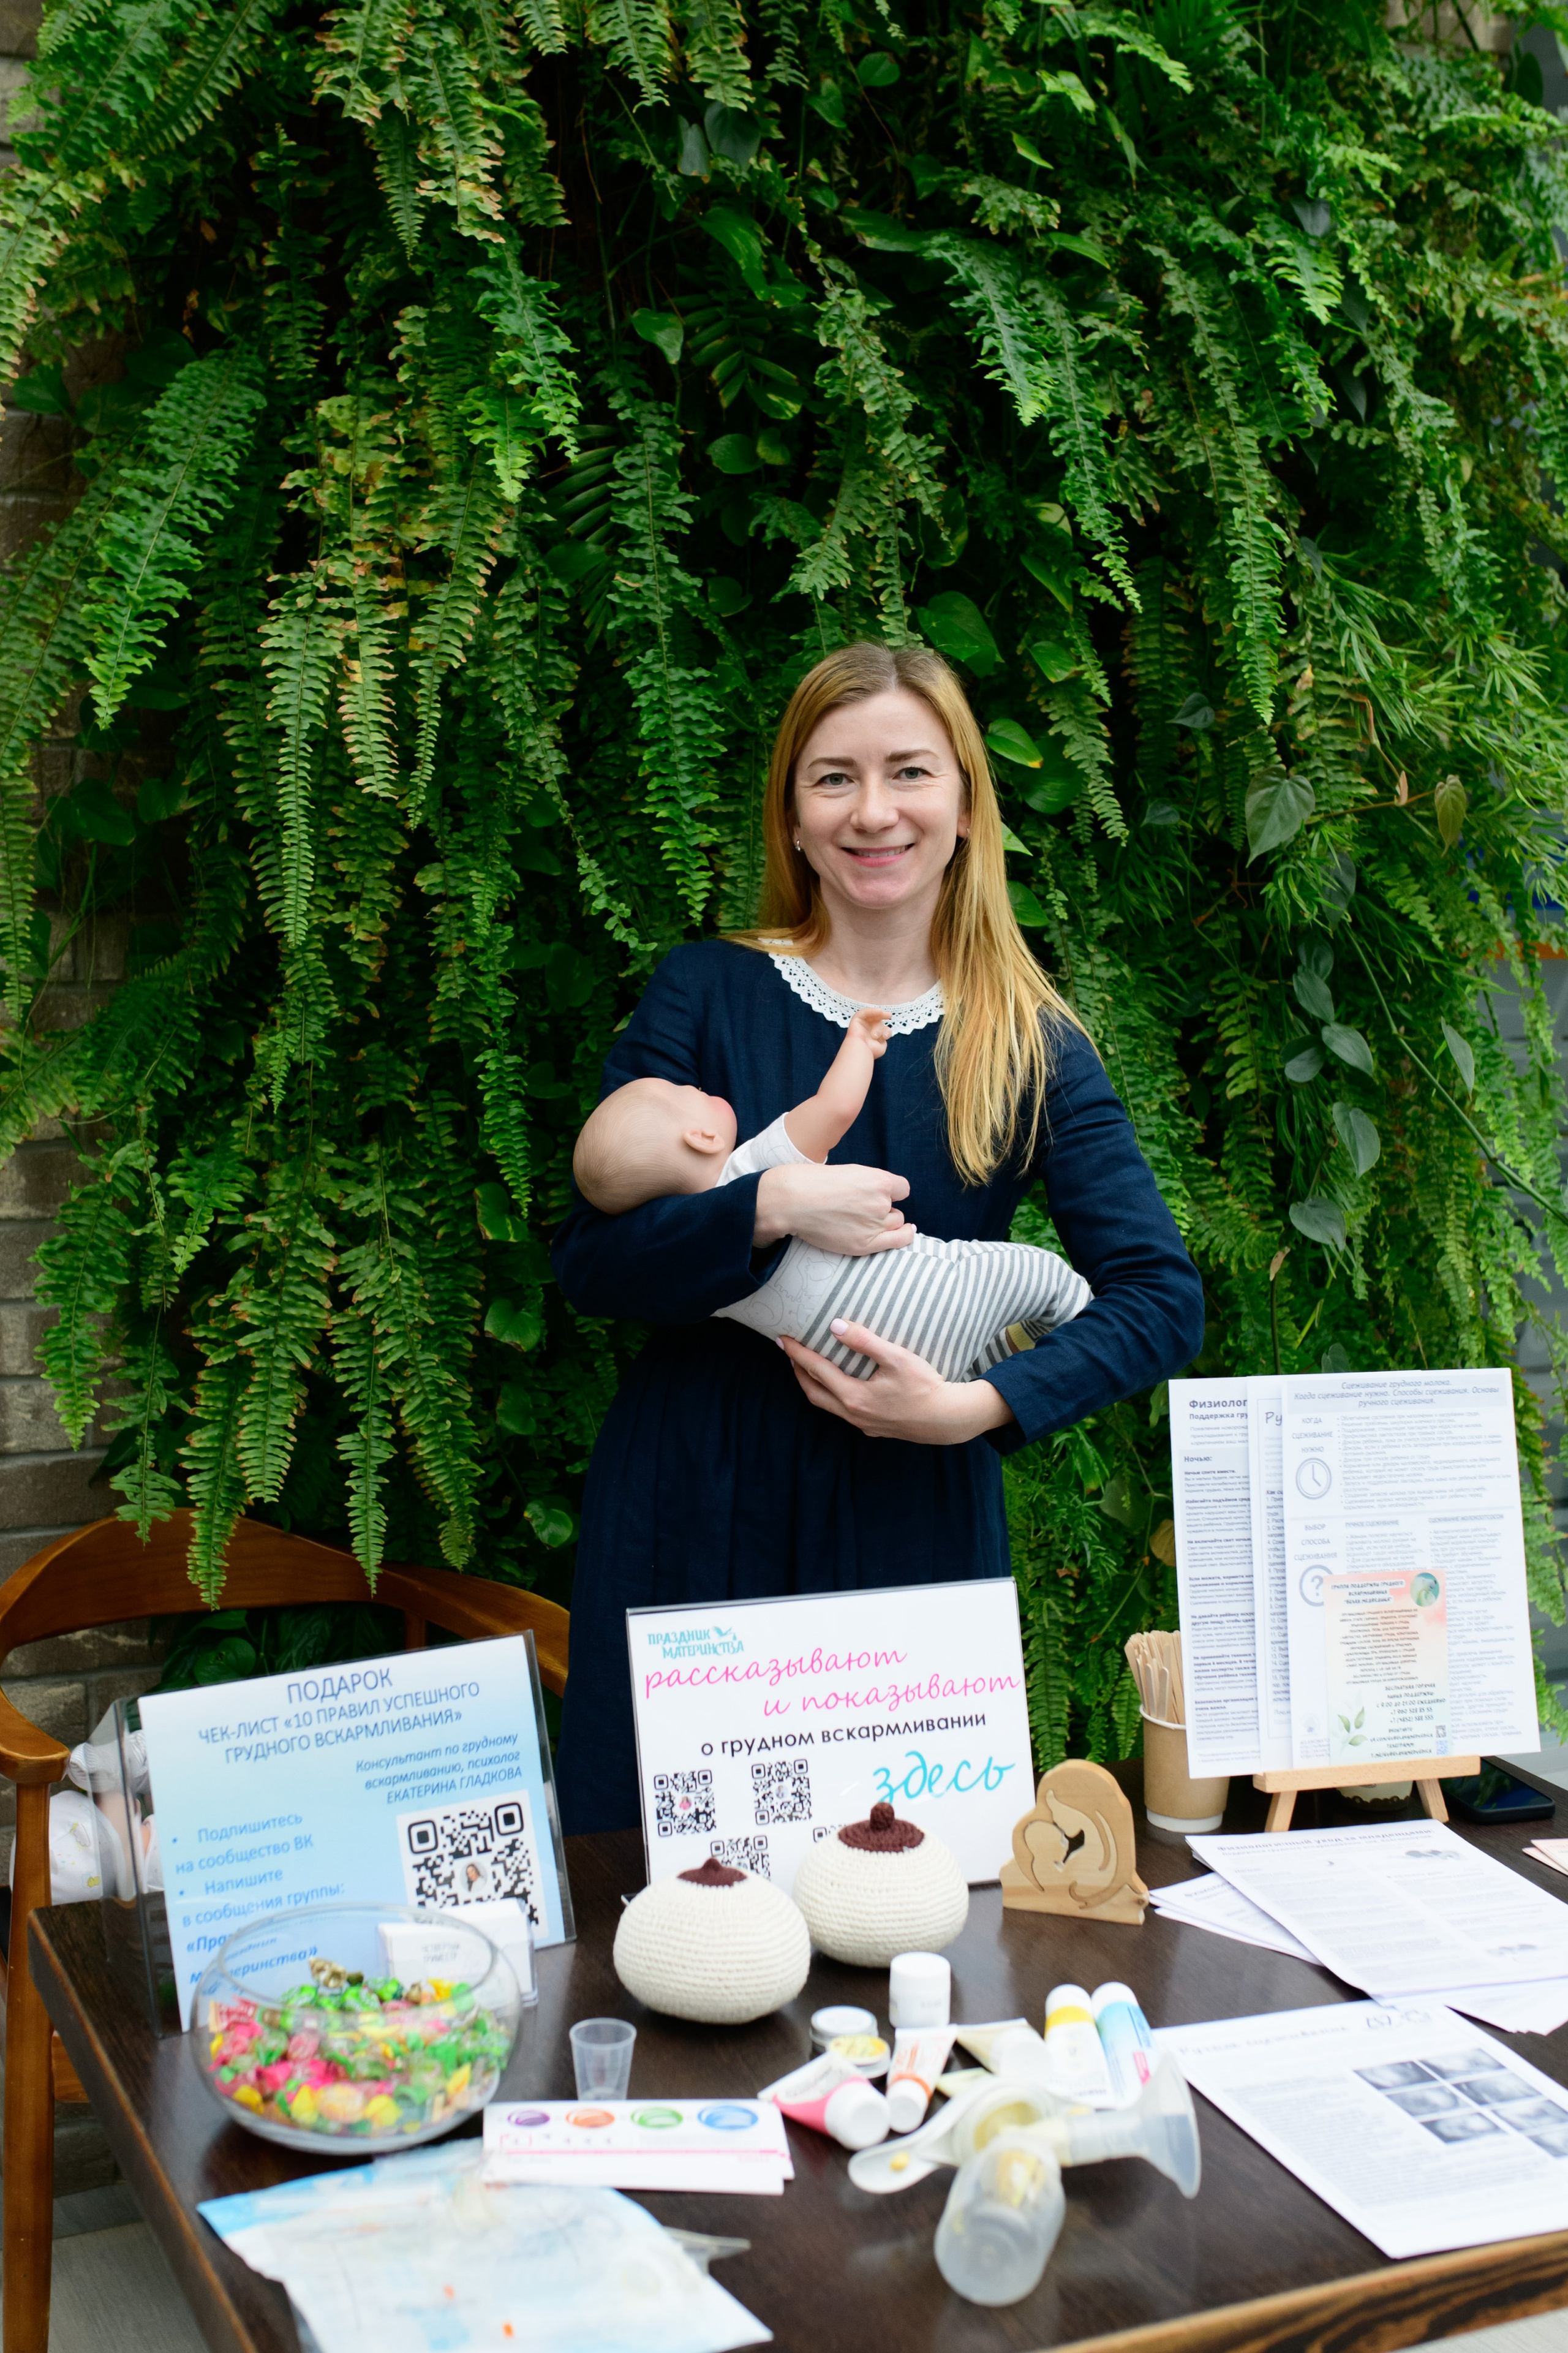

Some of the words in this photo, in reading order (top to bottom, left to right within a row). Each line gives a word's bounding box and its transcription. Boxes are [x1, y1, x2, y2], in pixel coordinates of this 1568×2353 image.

[647, 1628, 710, 1645] ПРАЗДНИК
[662, 1639, 744, 1659] МАТЕРИНСТВА
[287, 1669, 393, 1704] ПОДАРОК
[646, 1648, 907, 1699] рассказывают
[199, 1717, 278, 1745] ЧЕК-ЛИСТ
[284, 1710, 312, 1731] «10
[316, 1699, 380, 1724] ПРАВИЛ
[385, 1680, 480, 1712] УСПЕШНОГО
[764, 1698, 791, 1717] и
[802, 1673, 1021, 1712] показывают
[225, 1734, 310, 1766] ГРУДНОГО
[315, 1707, 462, 1749] ВСКАРМЛИВАНИЯ»
[355, 1747, 441, 1773] Консультант
[445, 1744, 459, 1756] по
[462, 1732, 518, 1753] грудному
[701, 1742, 714, 1756] о
[721, 1731, 815, 1757] грудном
[821, 1713, 987, 1743] вскармливании
[365, 1762, 464, 1790] вскармливанию,
[467, 1751, 519, 1770] психолог
[386, 1780, 456, 1804] ЕКАТЕРИНА
[460, 1766, 522, 1791] ГЛАДКОВА
[872, 1751, 1016, 1804] здесь
[197, 1813, 303, 1843] Подпишитесь
[175, 1860, 194, 1875] на
[198, 1840, 290, 1870] сообщество
[294, 1833, 314, 1851] ВК
[205, 1868, 283, 1895] Напишите
[183, 1915, 190, 1927] в
[195, 1895, 282, 1924] сообщения
[287, 1882, 344, 1905] группы:
[190, 1946, 317, 1978] меринства»
